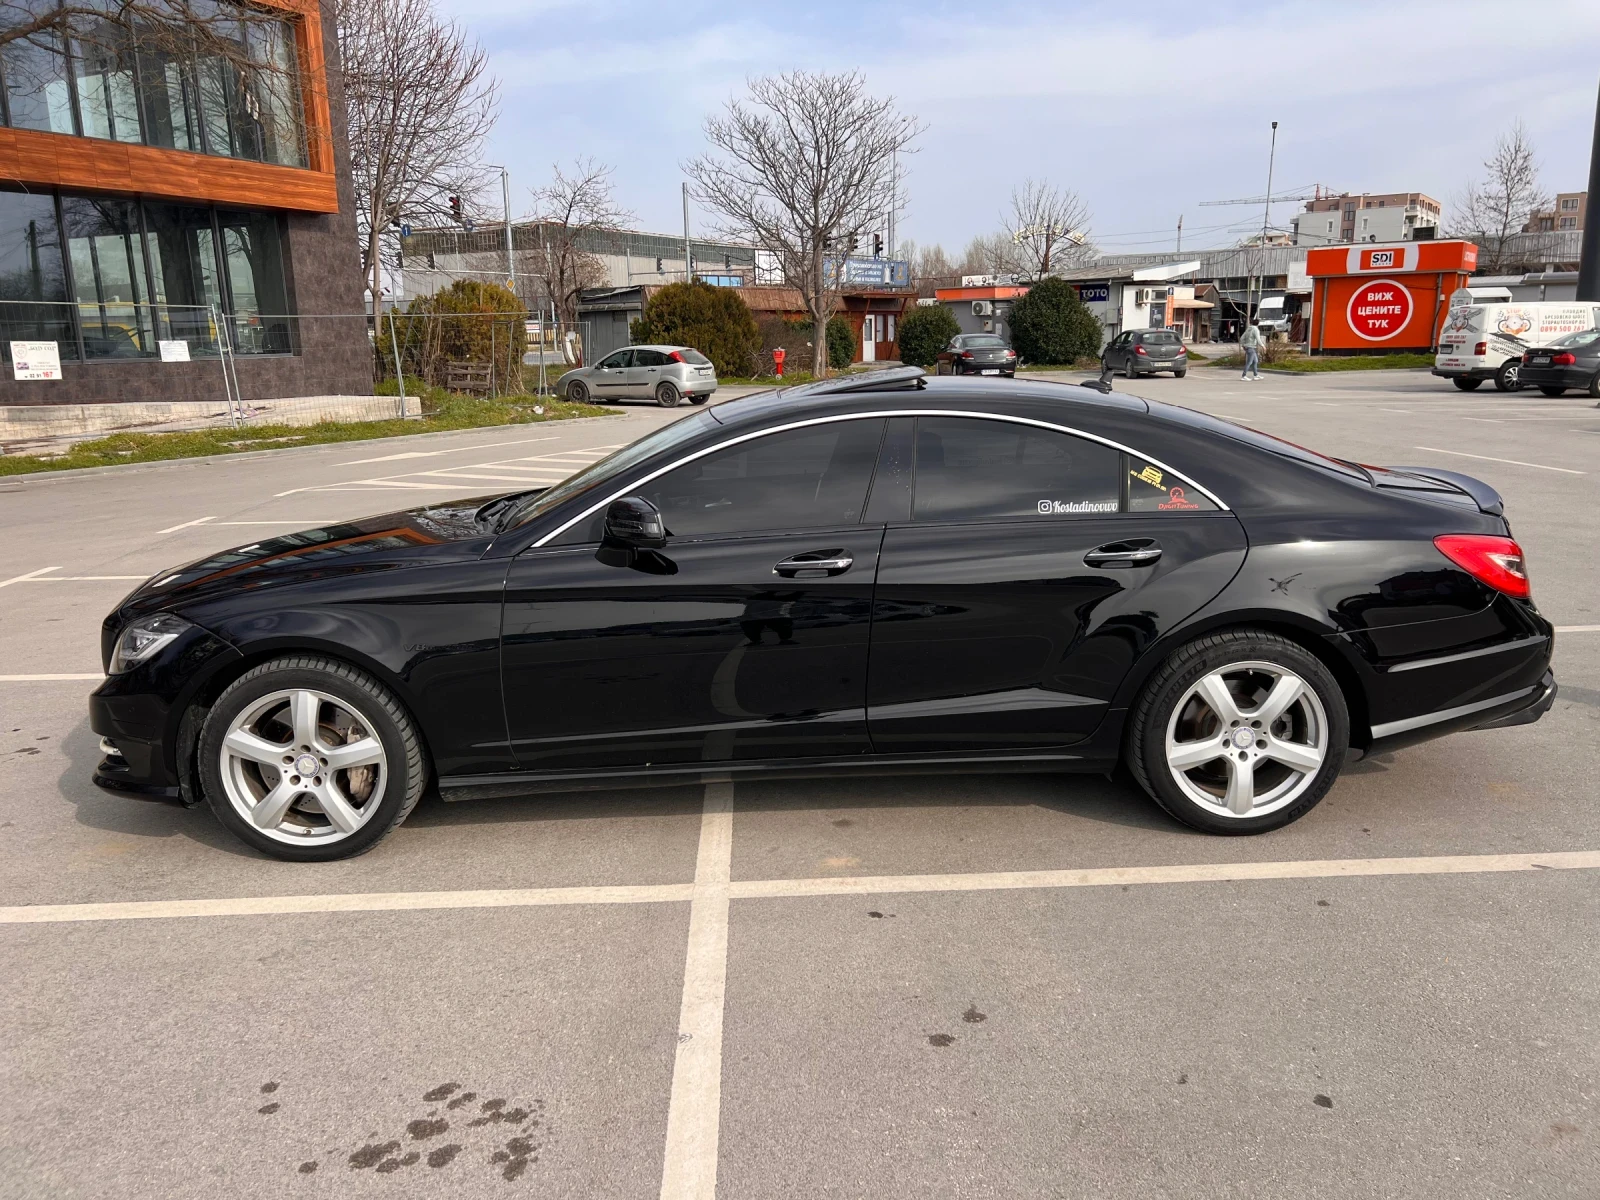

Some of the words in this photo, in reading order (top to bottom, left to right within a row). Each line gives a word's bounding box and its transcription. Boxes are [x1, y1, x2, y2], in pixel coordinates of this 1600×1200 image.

[1371, 253, 1392, 264] SDI
[1367, 292, 1394, 302] ВИЖ
[1357, 305, 1402, 316] ЦЕНИТЕ
[1367, 319, 1389, 328] ТУК
